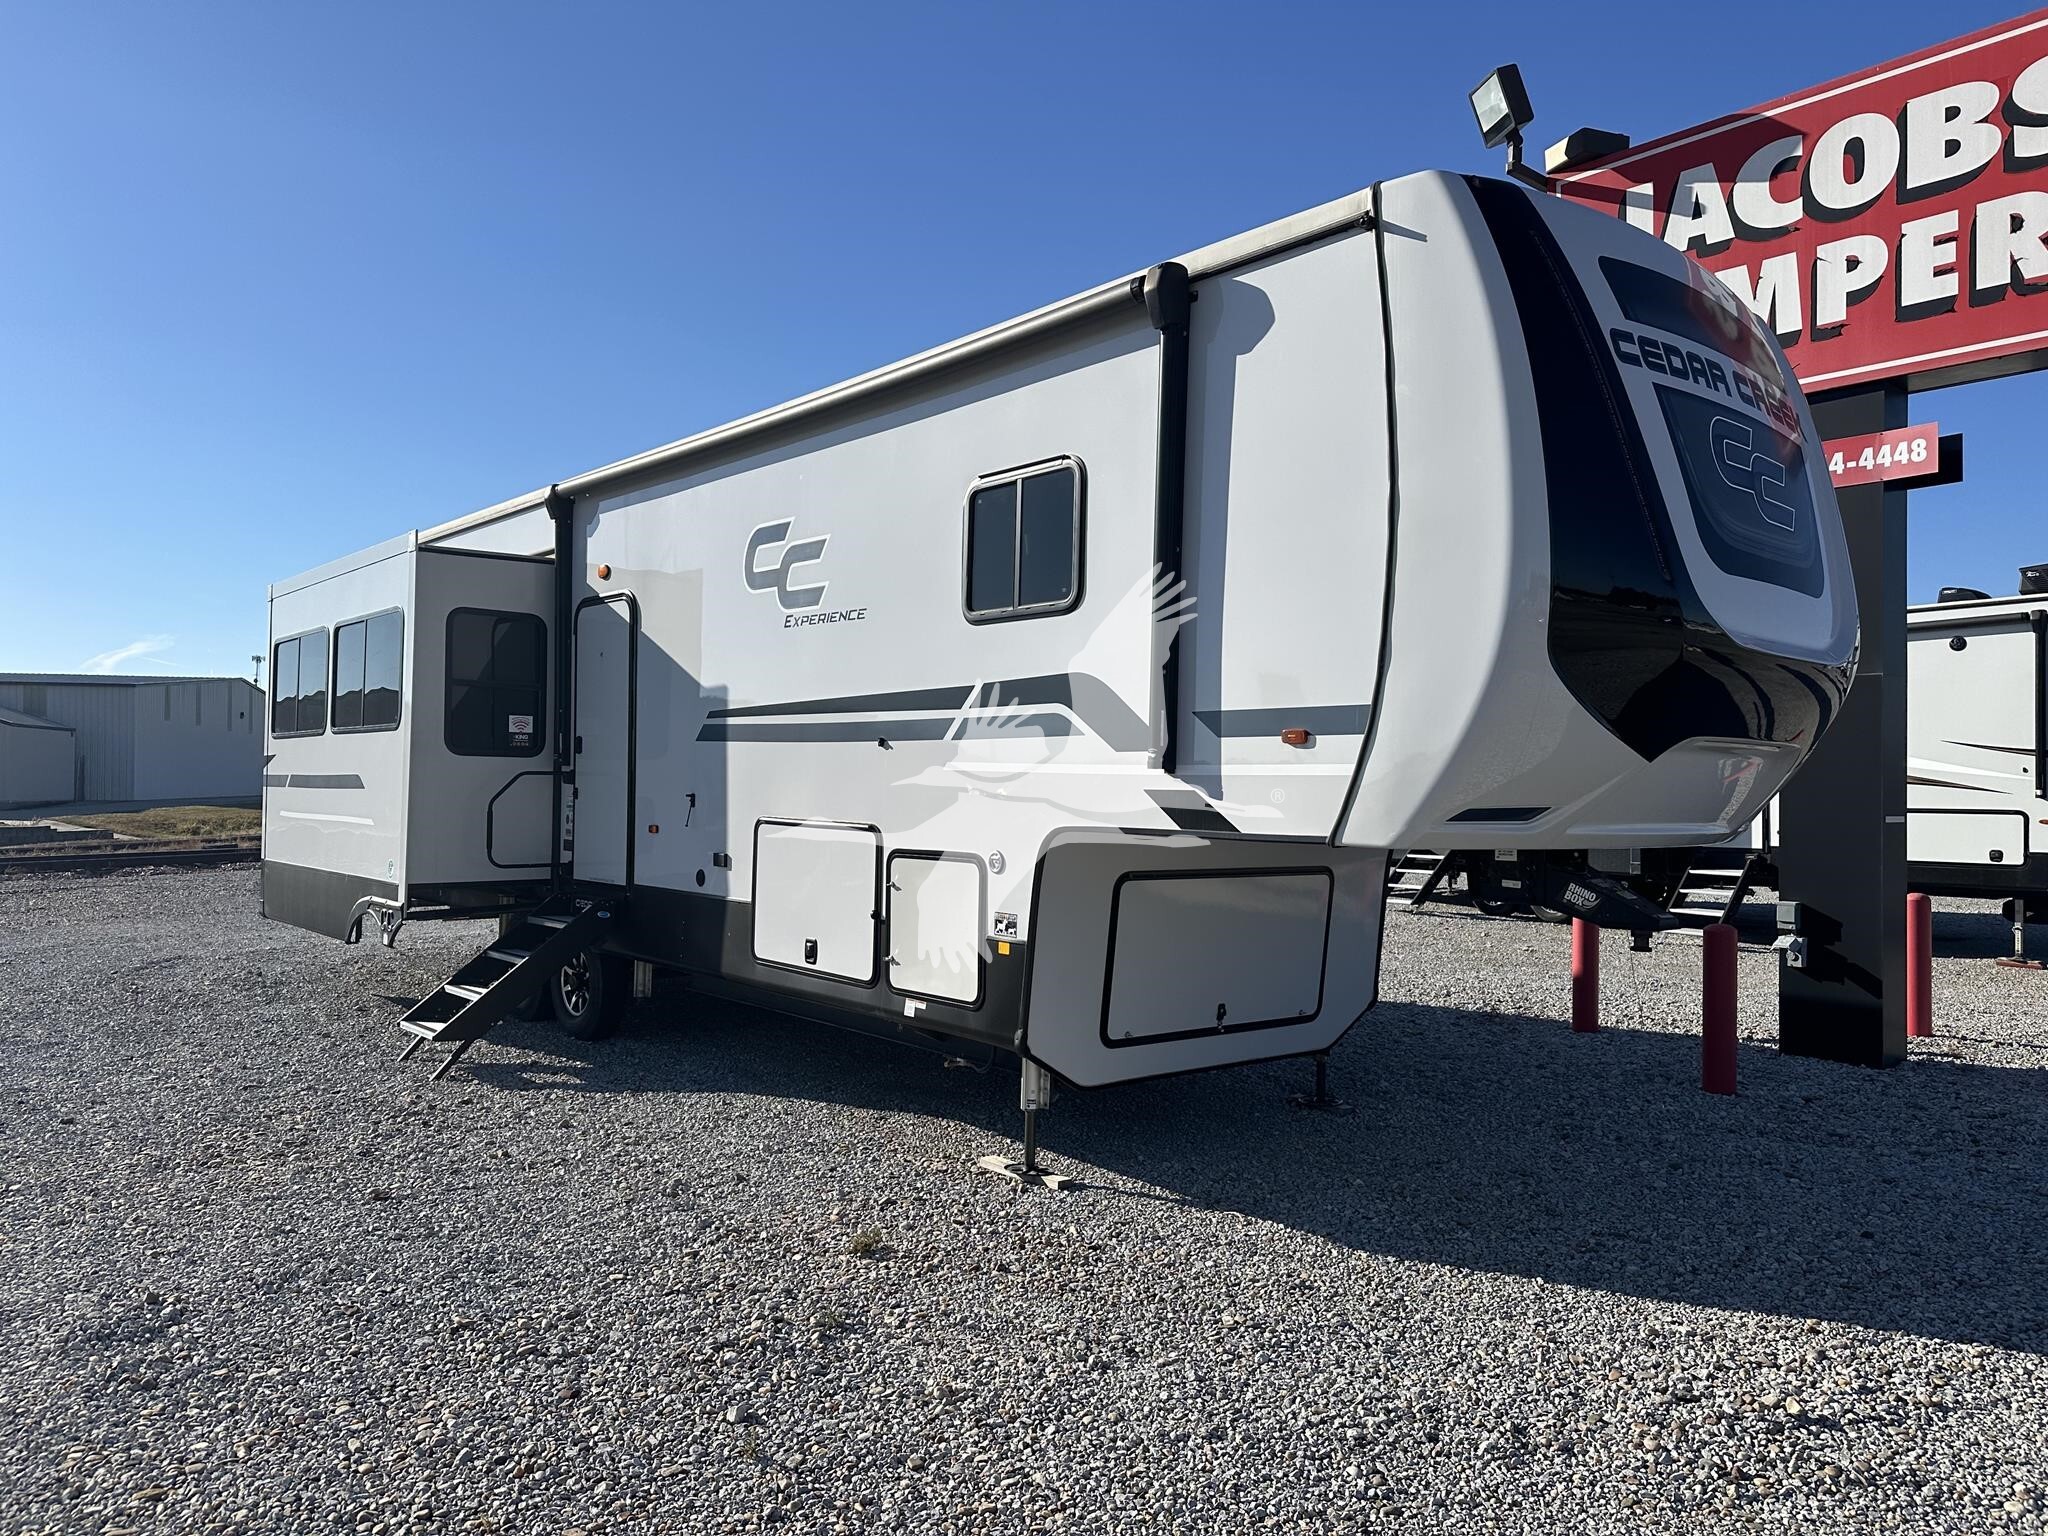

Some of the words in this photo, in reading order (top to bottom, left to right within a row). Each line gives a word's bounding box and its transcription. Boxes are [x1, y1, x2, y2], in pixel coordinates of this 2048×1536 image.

[1609, 327, 1733, 398] CEDAR
[1709, 415, 1796, 532] CC
[1824, 438, 1928, 475] 4-4448
[743, 516, 831, 613] CC
[1564, 890, 1585, 906] BOX
[1567, 882, 1597, 902] RHINO
